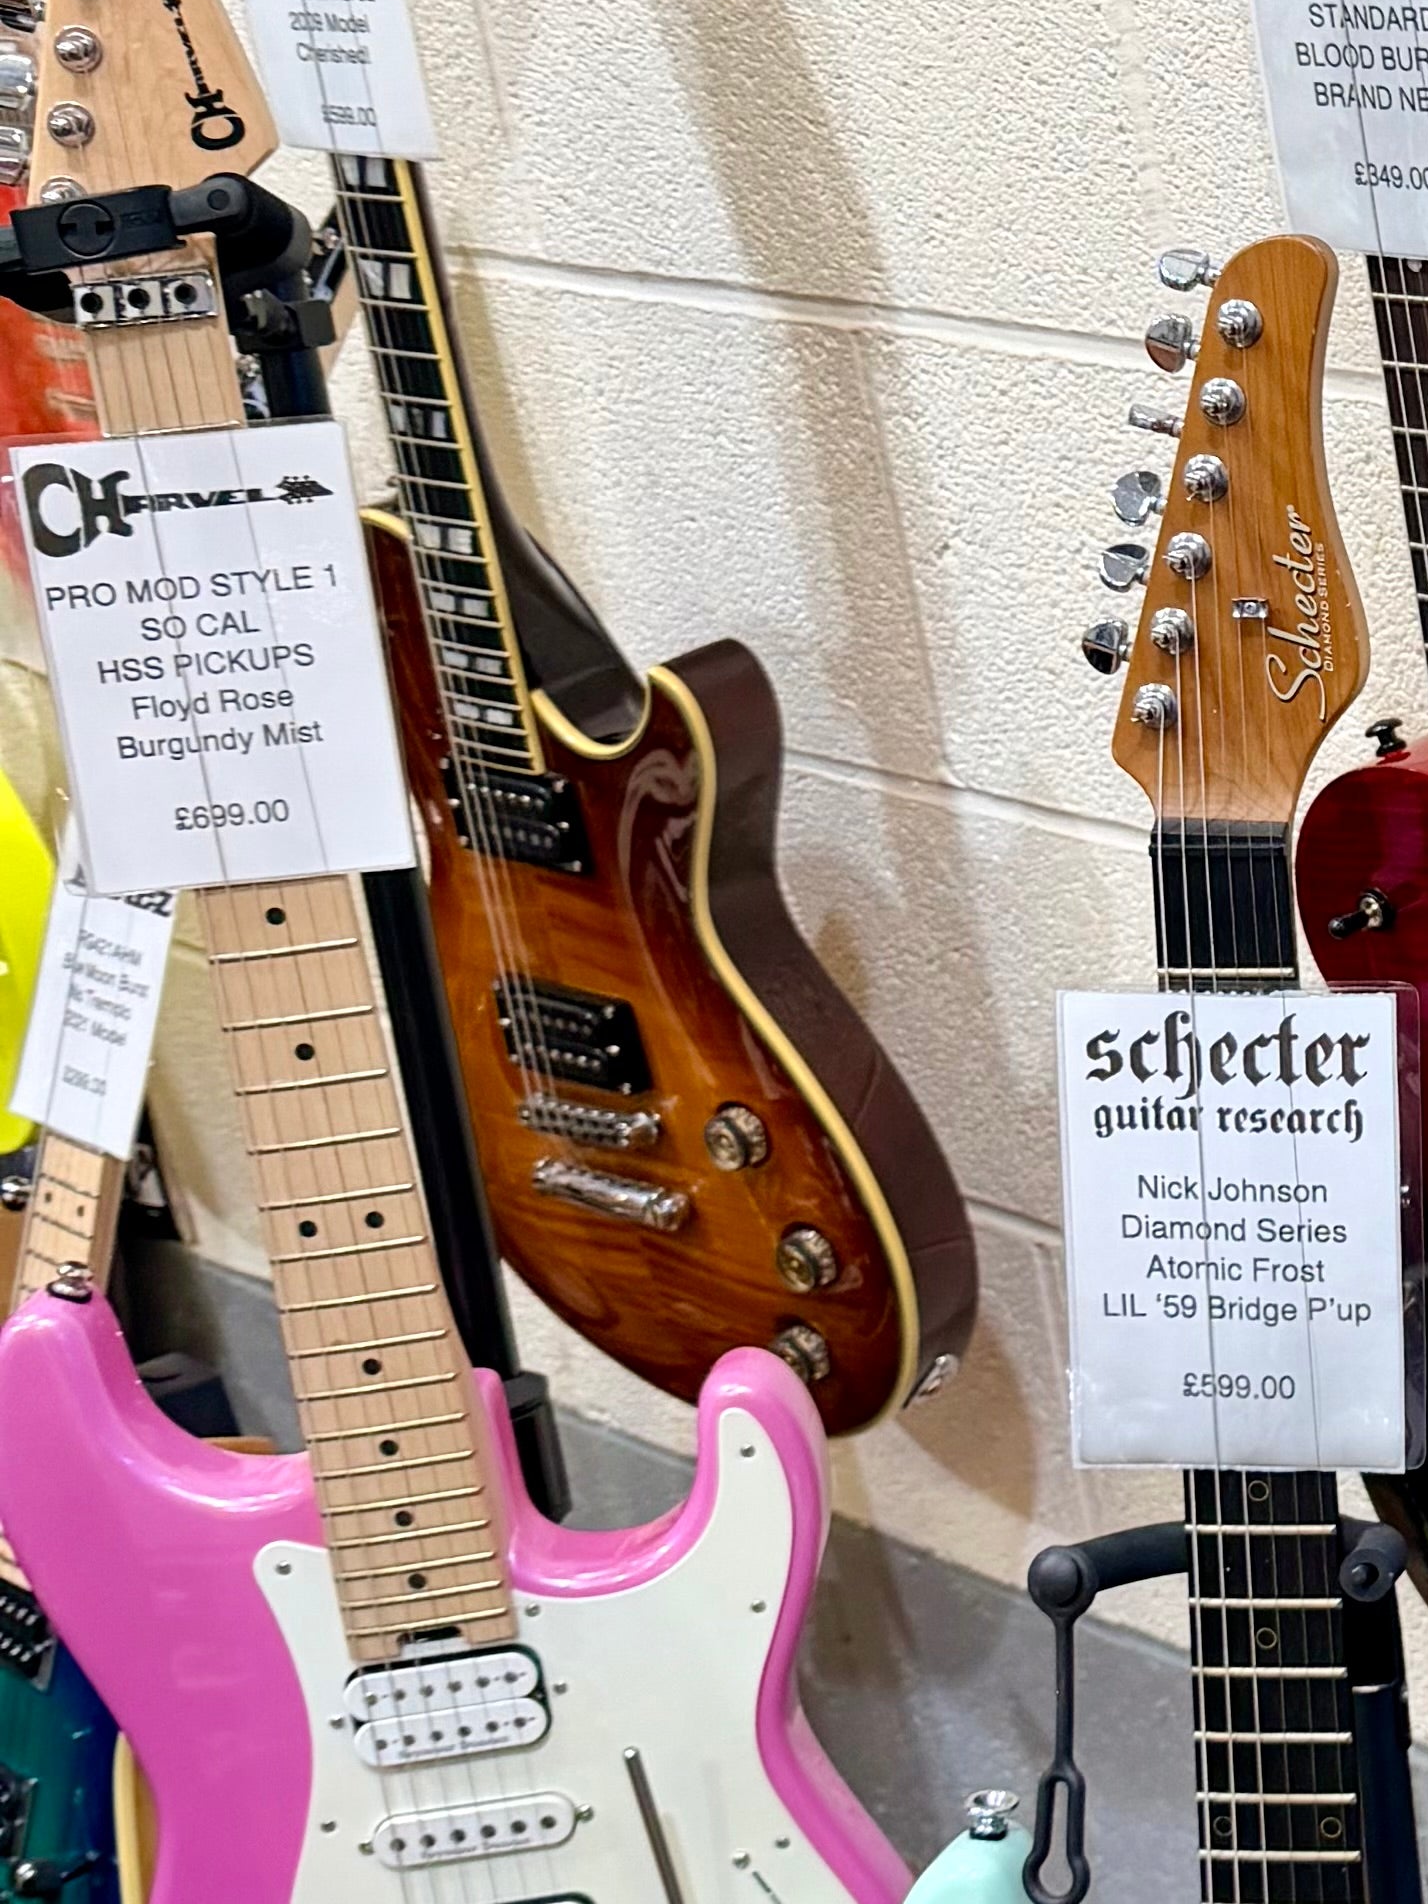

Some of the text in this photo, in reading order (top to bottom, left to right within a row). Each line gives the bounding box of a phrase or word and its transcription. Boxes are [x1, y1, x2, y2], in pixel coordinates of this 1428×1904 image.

[1294, 42, 1376, 71] BLOOD
[1313, 81, 1394, 112] BRAND
[21, 462, 285, 558] CHARVEL
[45, 563, 339, 611] PRO MOD STYLE 1
[1265, 504, 1326, 721] Schecter
[1314, 542, 1334, 673] DIAMOND SERIES
[141, 611, 261, 642] SO CAL
[97, 643, 316, 685] HSS PICKUPS
[132, 687, 295, 722] Floyd Rose
[116, 720, 324, 762] Burgundy Mist
[174, 798, 290, 832] £699.00
[1085, 1010, 1372, 1101] schecter
[1093, 1095, 1365, 1143] guitar research
[1137, 1174, 1328, 1204] Nick Johnson
[1121, 1213, 1348, 1245] Diamond Series
[1146, 1253, 1326, 1284] Atomic Frost
[1103, 1292, 1148, 1319] LIL
[1208, 1295, 1298, 1328] Bridge
[1308, 1296, 1373, 1329] P’up
[1182, 1372, 1297, 1401] £599.00
